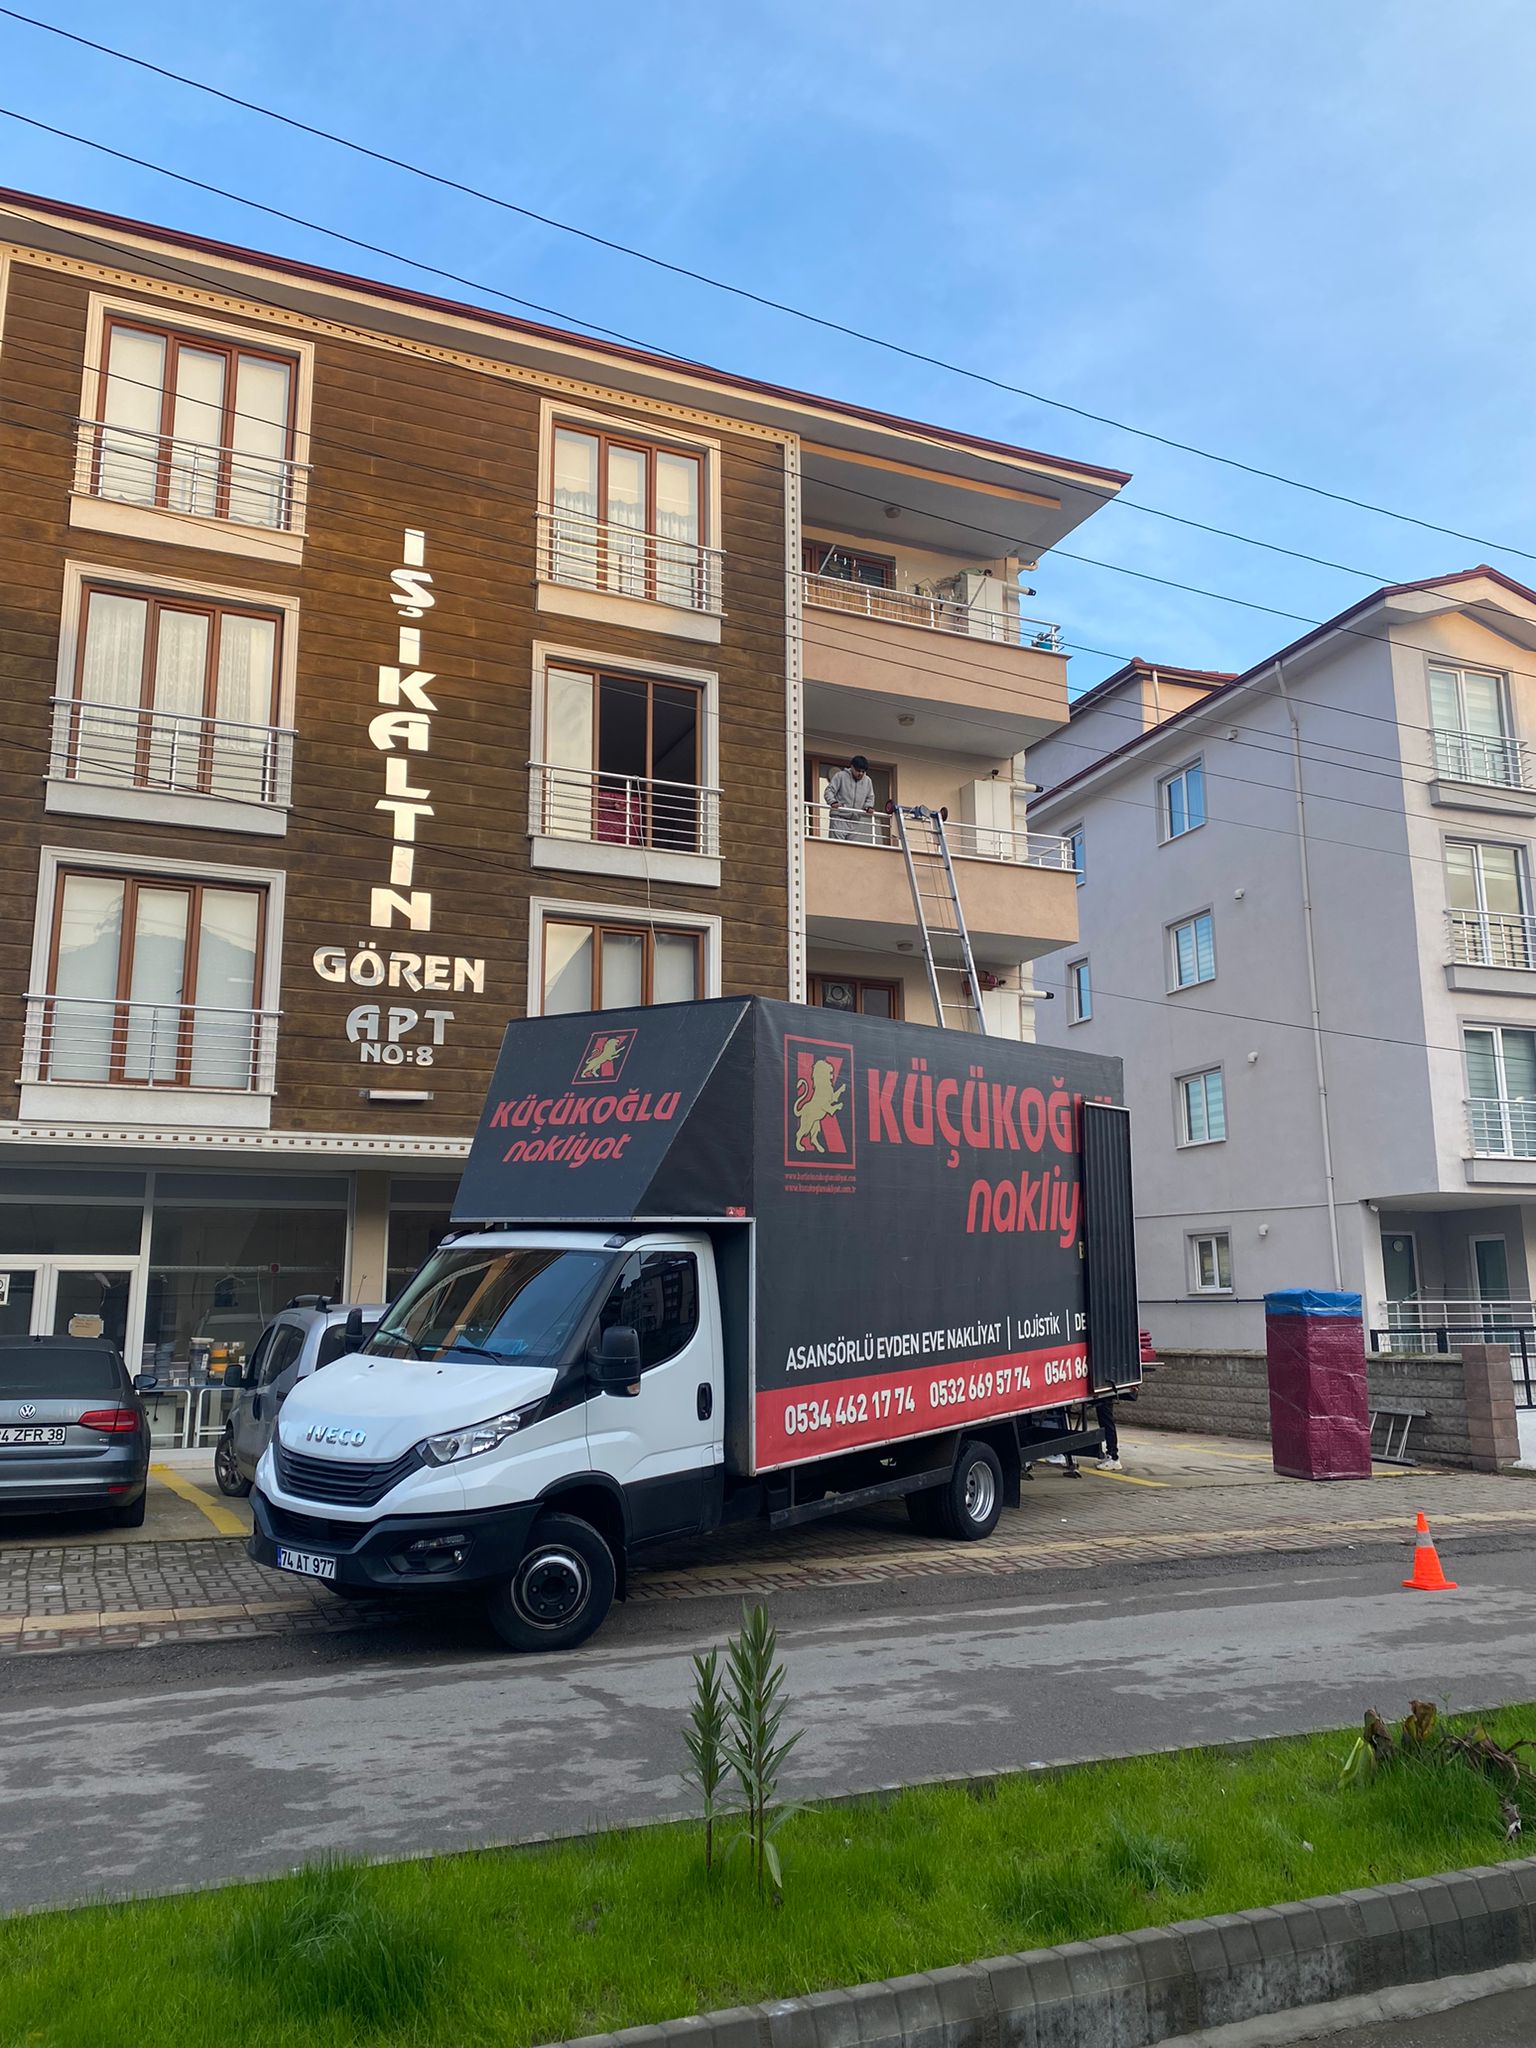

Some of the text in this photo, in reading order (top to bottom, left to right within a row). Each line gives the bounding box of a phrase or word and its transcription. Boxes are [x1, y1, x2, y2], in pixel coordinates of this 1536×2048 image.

[313, 941, 485, 993] GÖREN
[346, 1004, 455, 1045] APT
[360, 1042, 434, 1067] NO:8
[488, 1088, 682, 1134] KÜÇÜKOĞLU
[867, 1057, 1113, 1168] KÜÇÜKOĞ
[502, 1131, 632, 1169] nakliyat
[967, 1166, 1082, 1249] nakliy
[785, 1312, 1087, 1371] ASANSÖRLÜ EVDEN EVE NAKLİYAT LOJİSTİK DE
[785, 1355, 1088, 1435] 0534 462 17 74 0532 669 57 74 0541 86
[14, 1429, 43, 1441] ZFR
[47, 1428, 63, 1440] 38
[306, 1424, 367, 1448] IVECO
[281, 1550, 335, 1577] 74 AT 977
